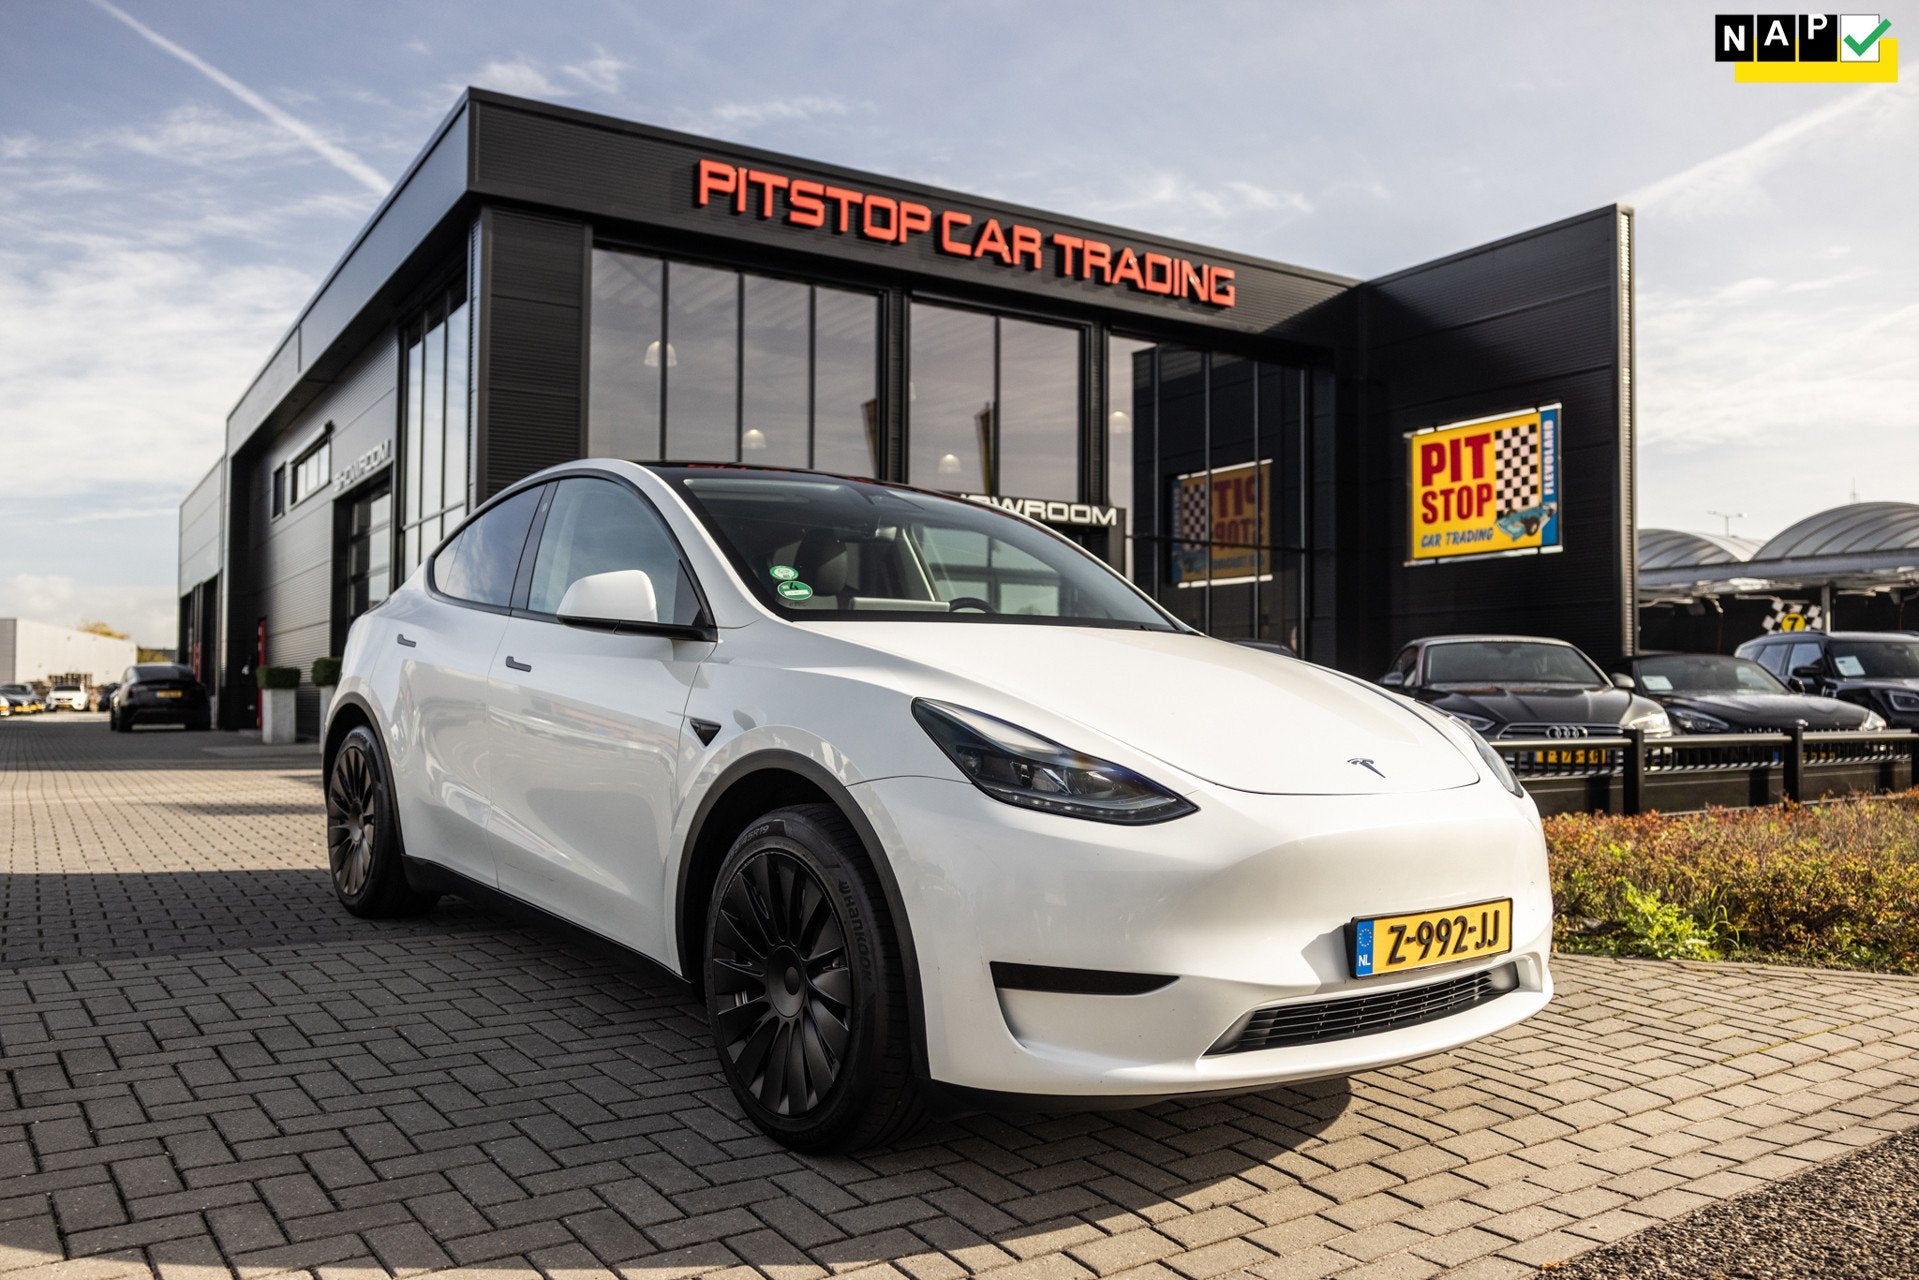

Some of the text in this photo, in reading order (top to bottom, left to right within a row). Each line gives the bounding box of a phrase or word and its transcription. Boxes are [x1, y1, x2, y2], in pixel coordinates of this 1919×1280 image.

[699, 159, 1236, 307] PITSTOP CAR TRADING
[1421, 433, 1492, 487] PIT
[1421, 483, 1494, 525] STOP
[1421, 527, 1494, 548] CAR TRADING
[1787, 616, 1799, 631] 7
[1387, 909, 1500, 965] Z-992-JJ
[1358, 954, 1371, 967] NL
